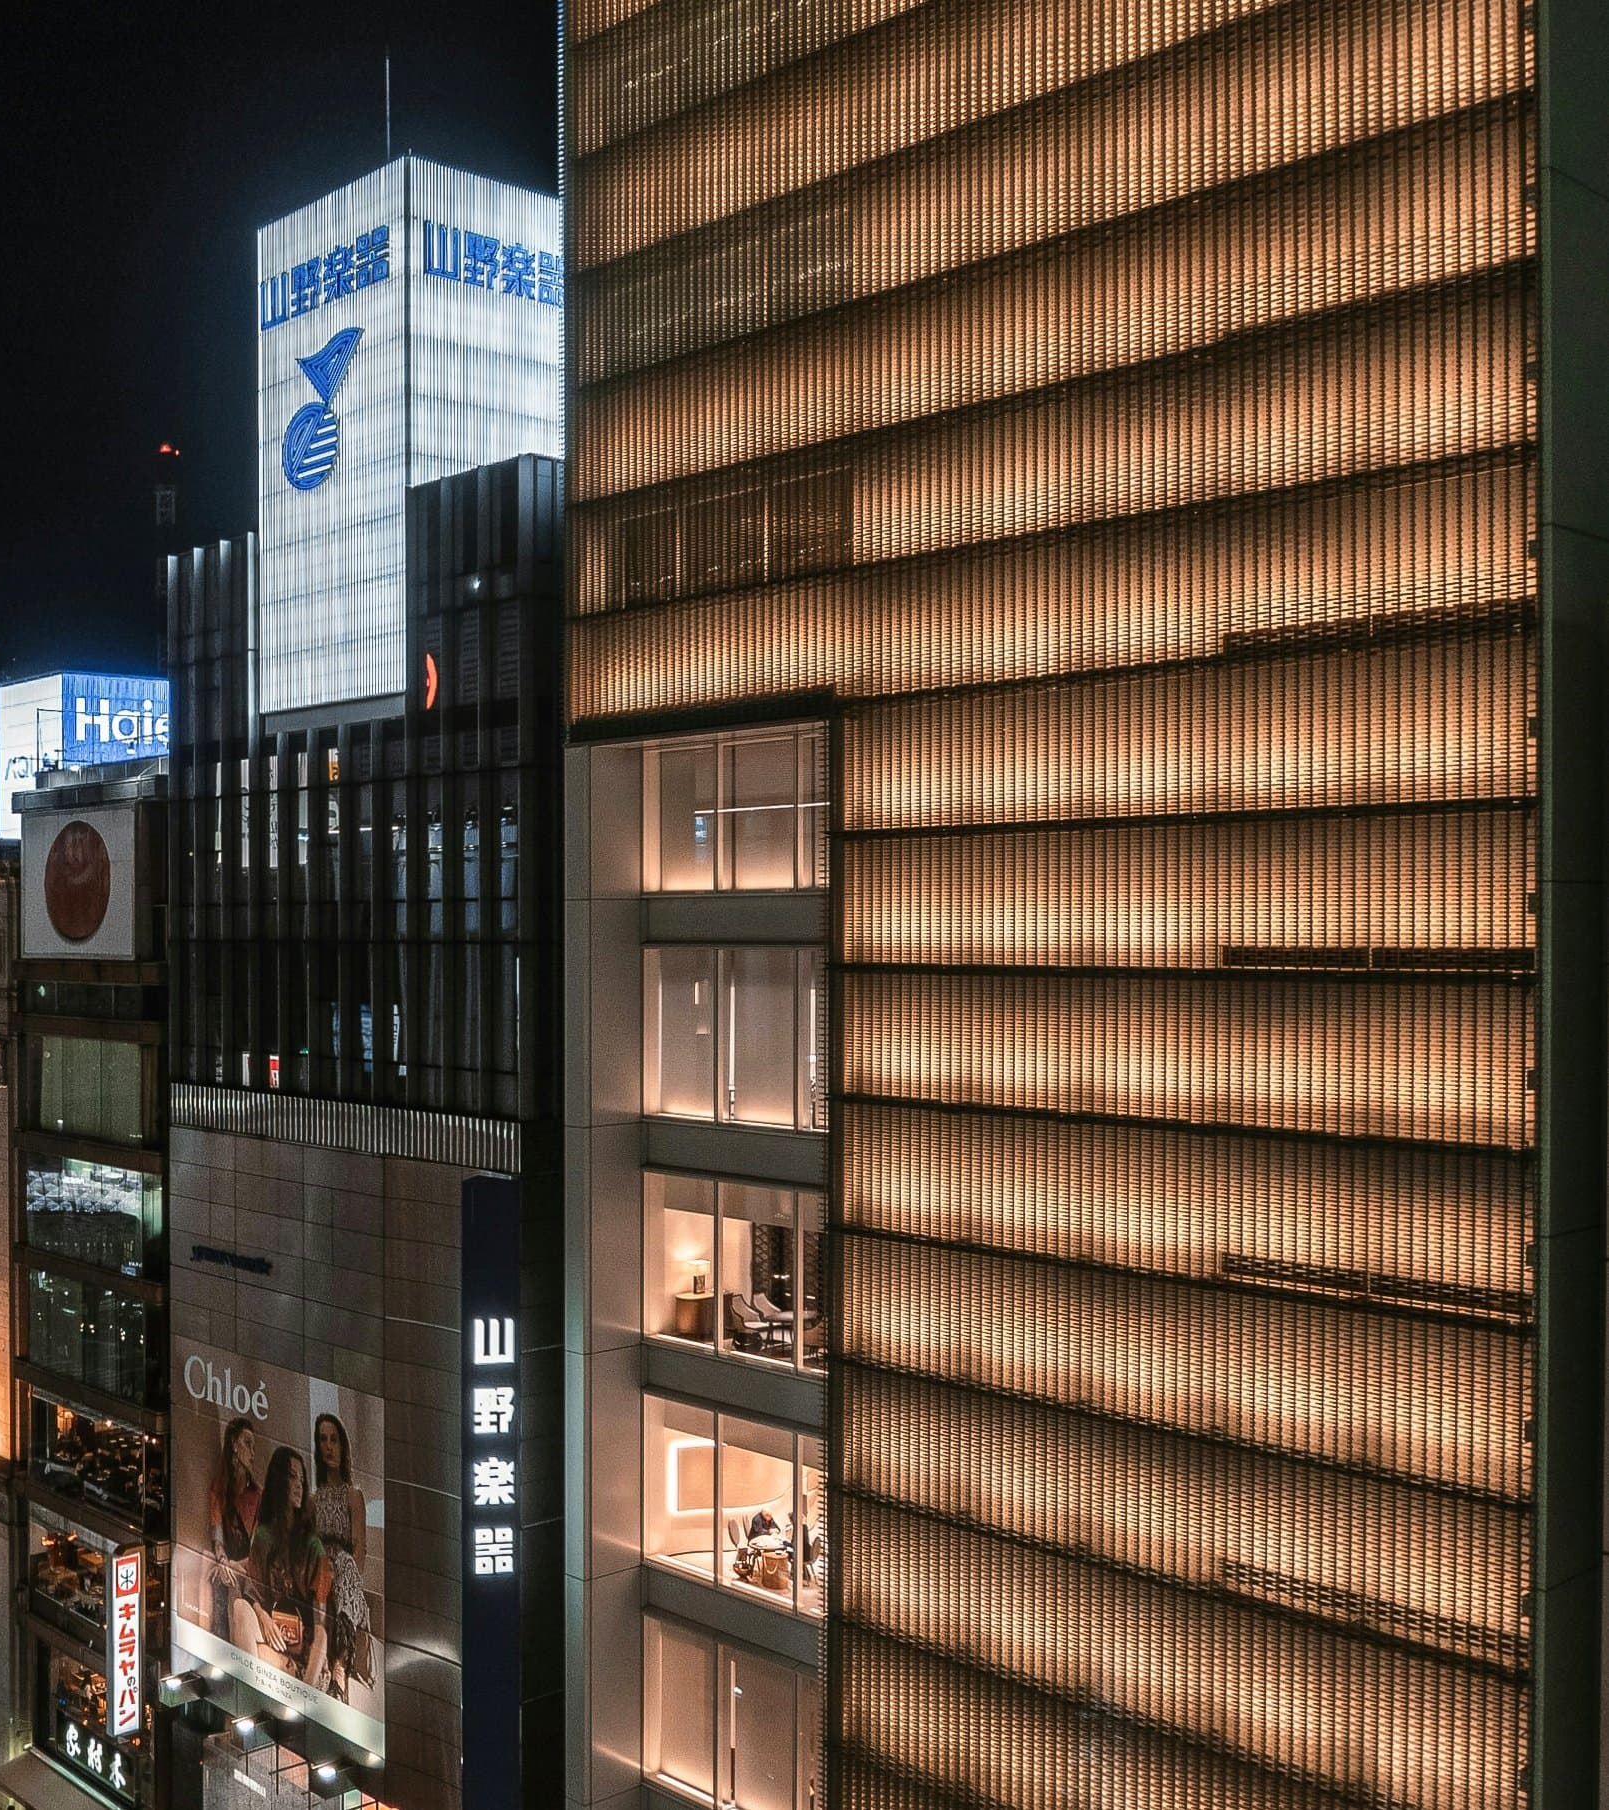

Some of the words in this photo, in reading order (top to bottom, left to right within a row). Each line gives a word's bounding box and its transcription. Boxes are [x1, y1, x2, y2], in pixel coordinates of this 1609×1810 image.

[260, 225, 389, 330] 山野楽器
[423, 220, 564, 309] 山野楽器
[184, 1355, 269, 1420] Chloé
[473, 1317, 515, 1575] 山野楽器
[118, 1602, 139, 1728] キムラヤのパン
